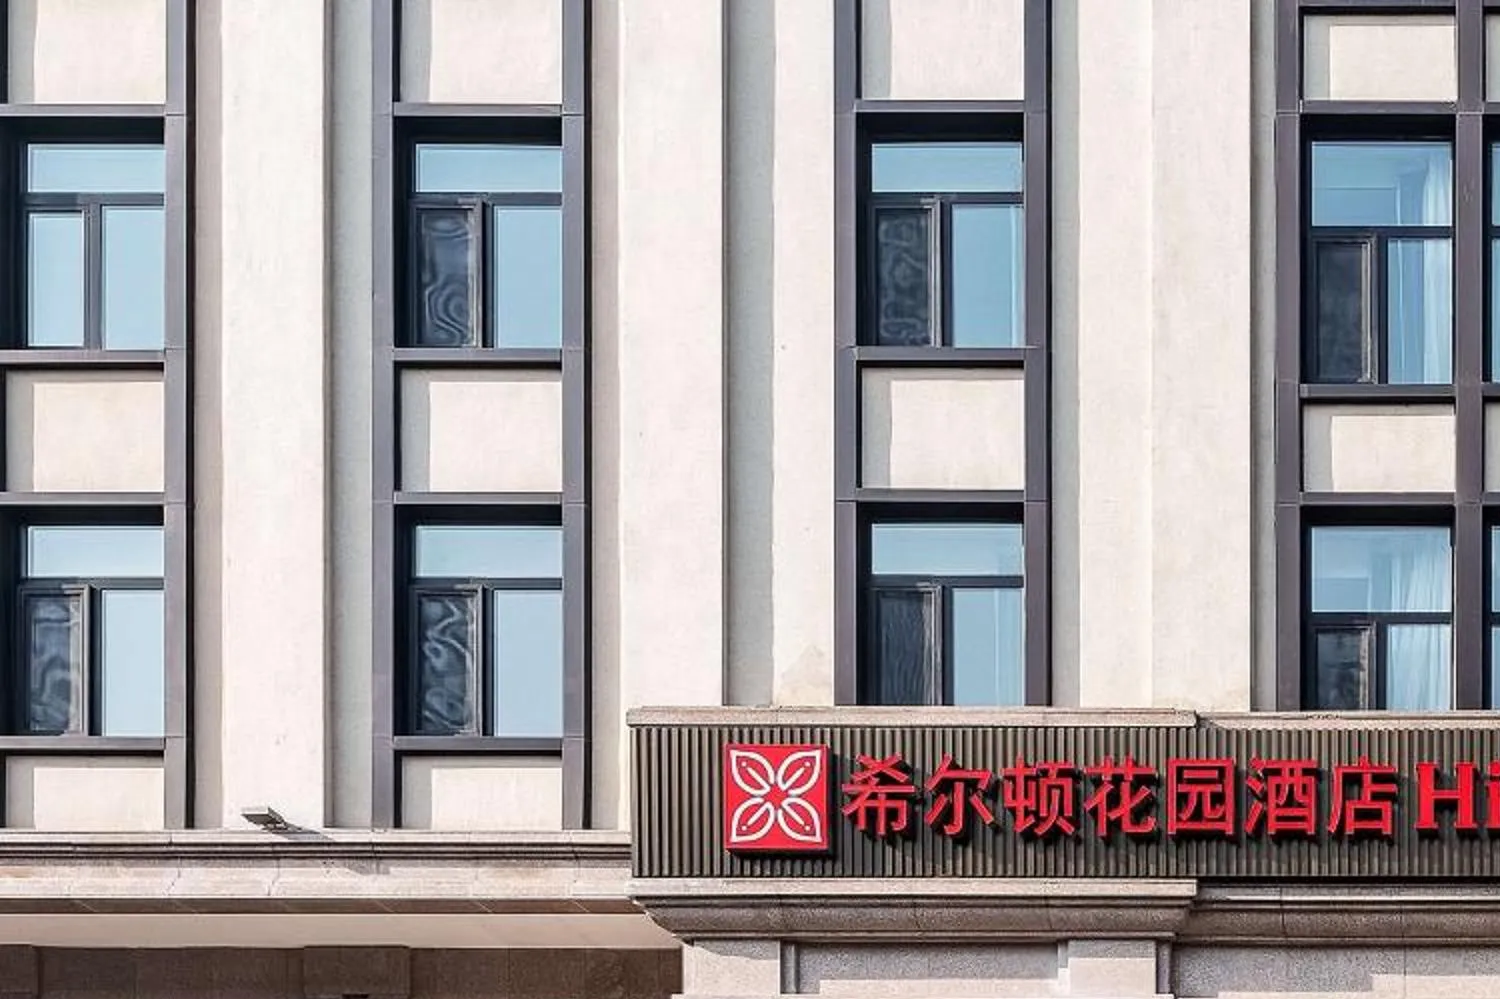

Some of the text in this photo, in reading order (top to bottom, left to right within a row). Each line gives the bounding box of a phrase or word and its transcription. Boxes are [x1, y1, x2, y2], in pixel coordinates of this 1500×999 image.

[842, 753, 1397, 835] 希尔顿花园酒店
